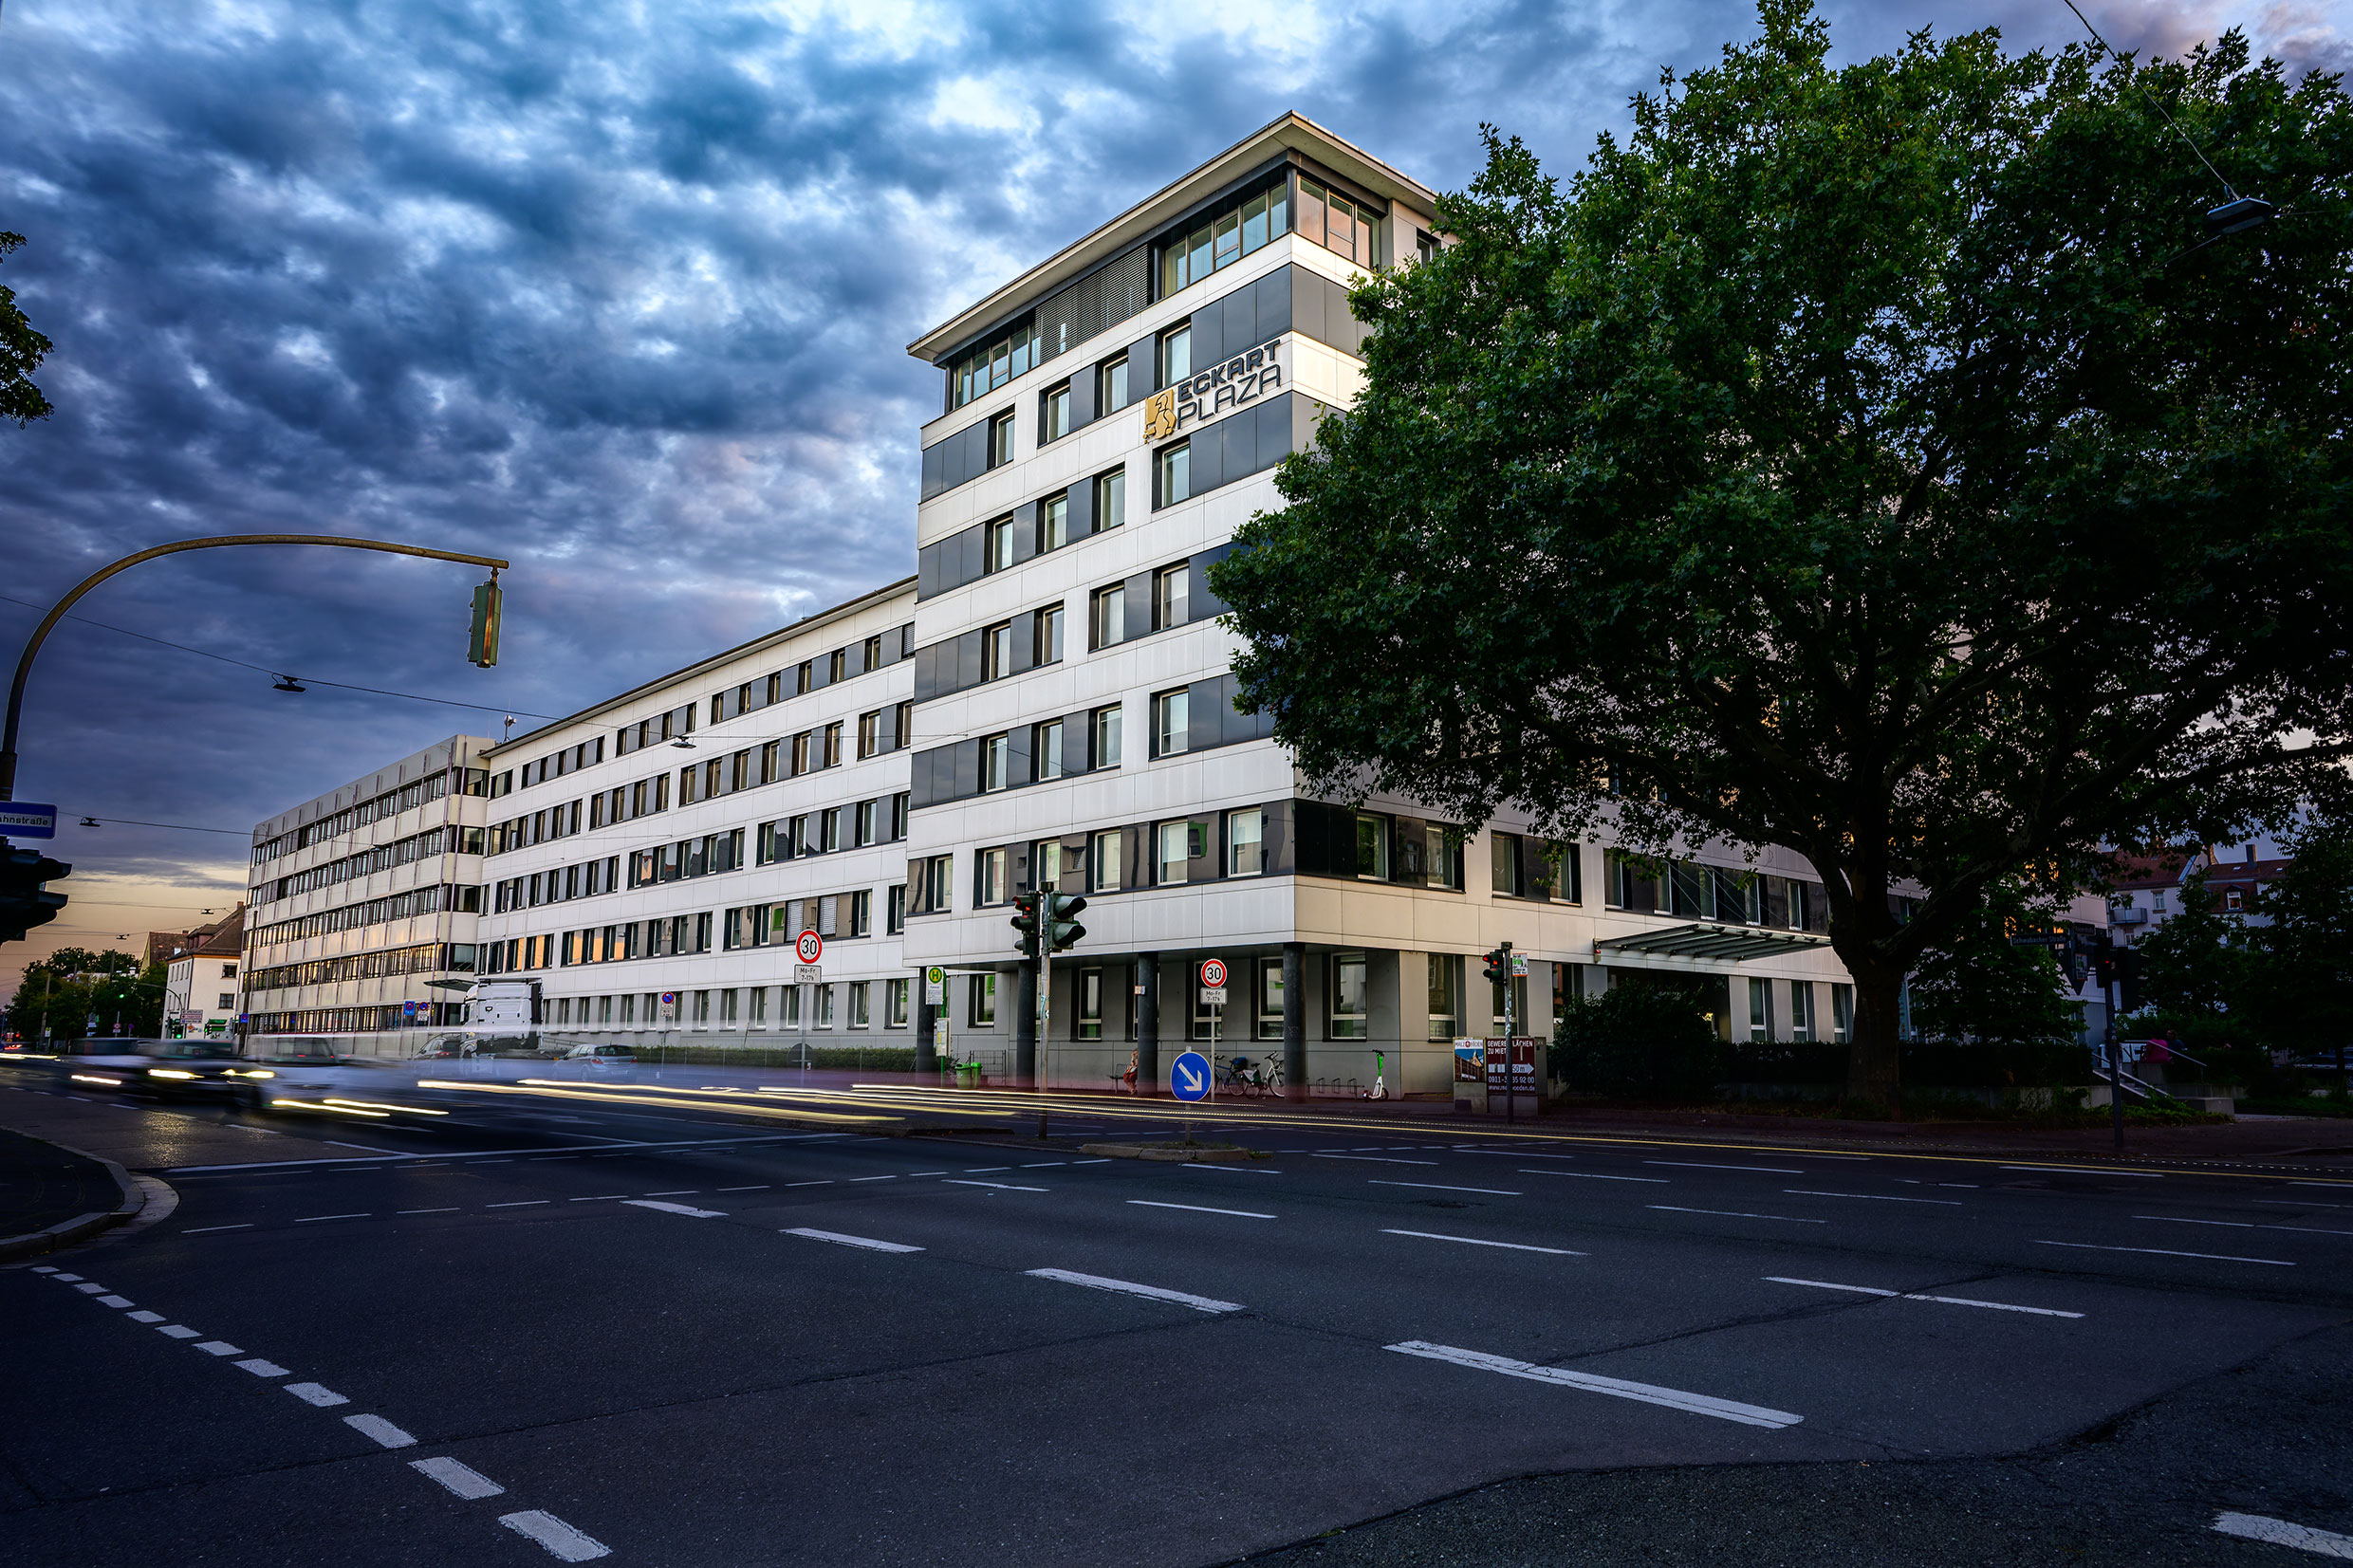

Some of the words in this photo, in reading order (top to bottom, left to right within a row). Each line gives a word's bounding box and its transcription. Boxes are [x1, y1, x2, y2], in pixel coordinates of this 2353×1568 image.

[1177, 339, 1281, 402] ECKART
[1177, 364, 1281, 430] PLAZA
[802, 939, 817, 955] 30
[1207, 967, 1221, 980] 30
